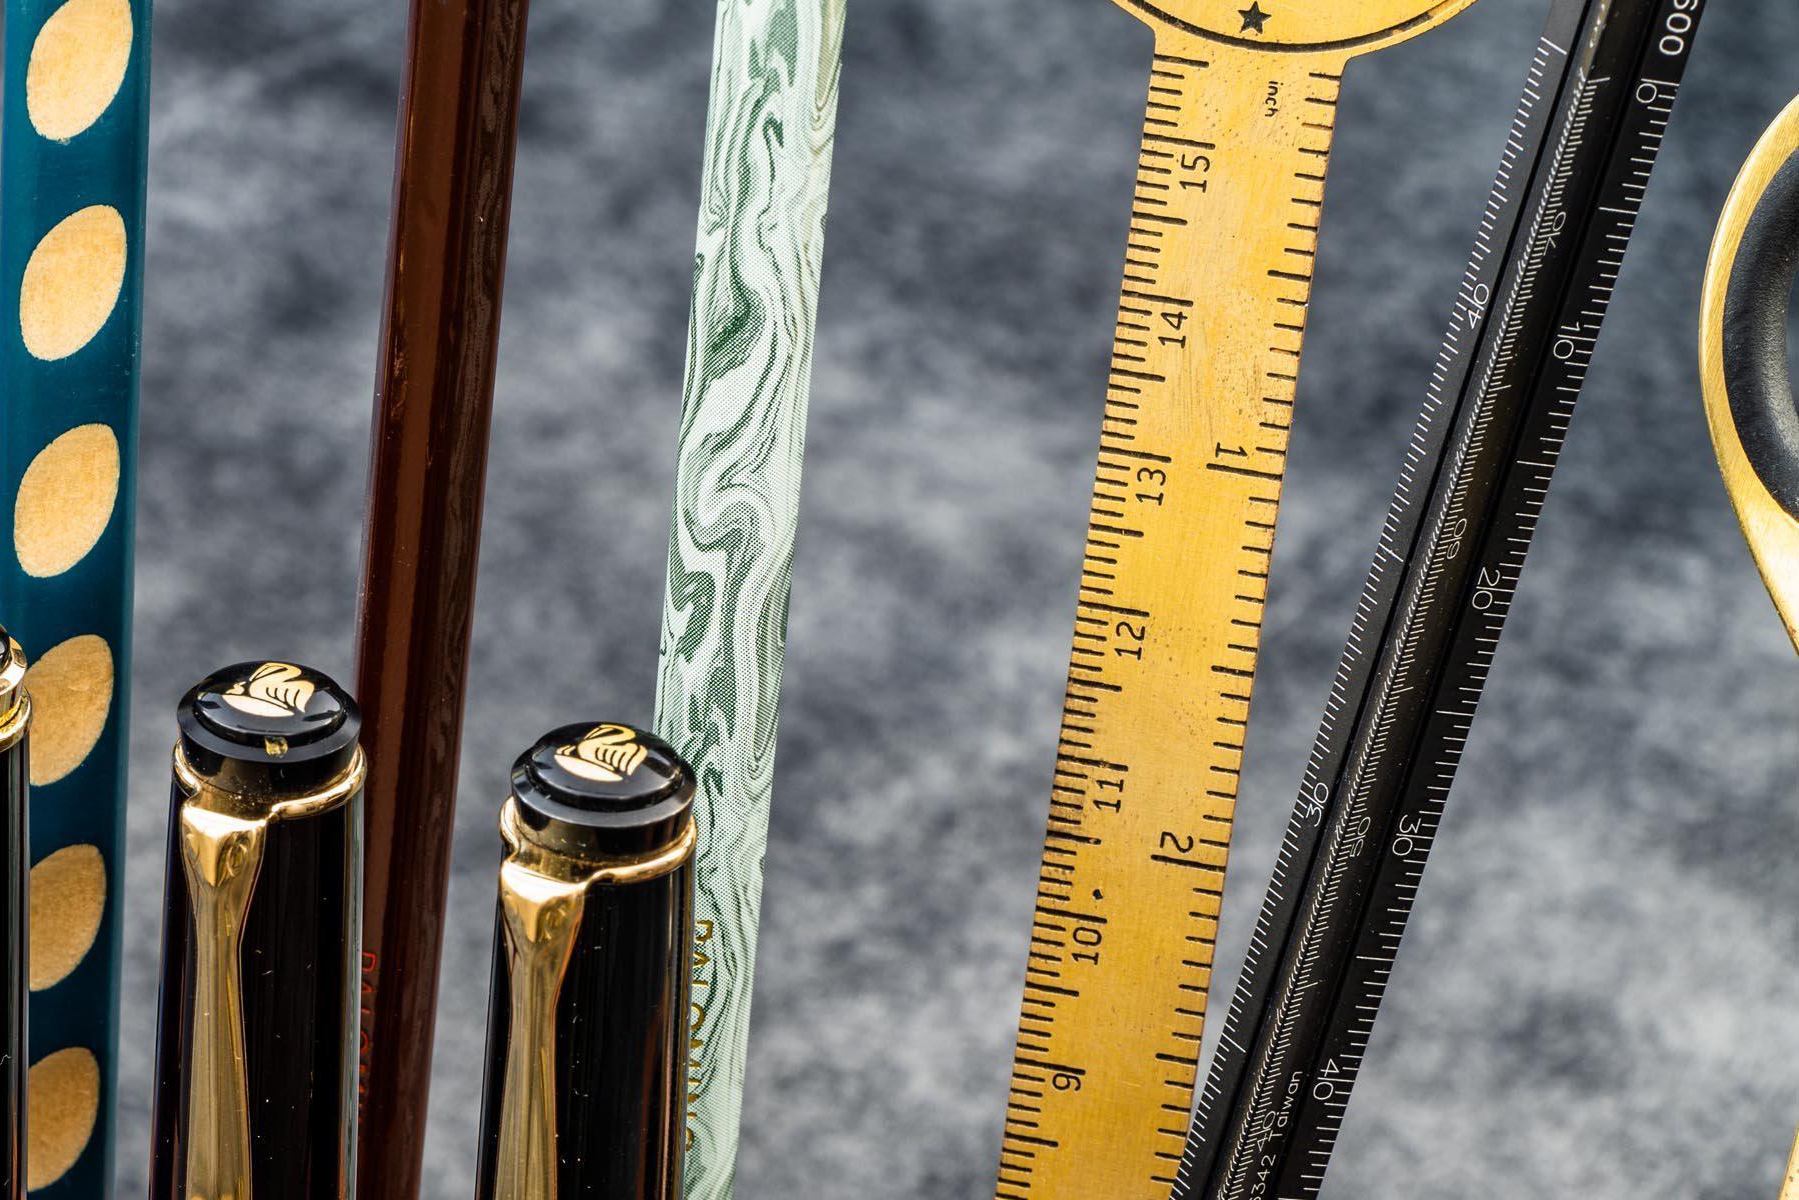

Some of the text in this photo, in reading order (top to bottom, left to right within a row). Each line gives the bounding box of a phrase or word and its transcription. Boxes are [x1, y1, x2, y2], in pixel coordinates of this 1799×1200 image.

[1264, 80, 1284, 117] inch
[1636, 83, 1657, 103] 0
[1179, 153, 1211, 193] 15
[1467, 282, 1490, 330] 40
[1159, 308, 1189, 350] 14
[1553, 321, 1581, 359] 10
[1214, 442, 1248, 463] 1
[1135, 467, 1168, 508] 13
[1472, 567, 1501, 609] 20
[1114, 621, 1148, 662] 12
[1093, 777, 1125, 814] 11
[1305, 782, 1329, 827] 30
[1159, 830, 1194, 854] 2
[1391, 813, 1421, 857] 30
[1072, 926, 1102, 965] 10
[1051, 1071, 1082, 1093] 9
[1313, 1058, 1339, 1101] 40
[1268, 1070, 1303, 1139] Taiwan
